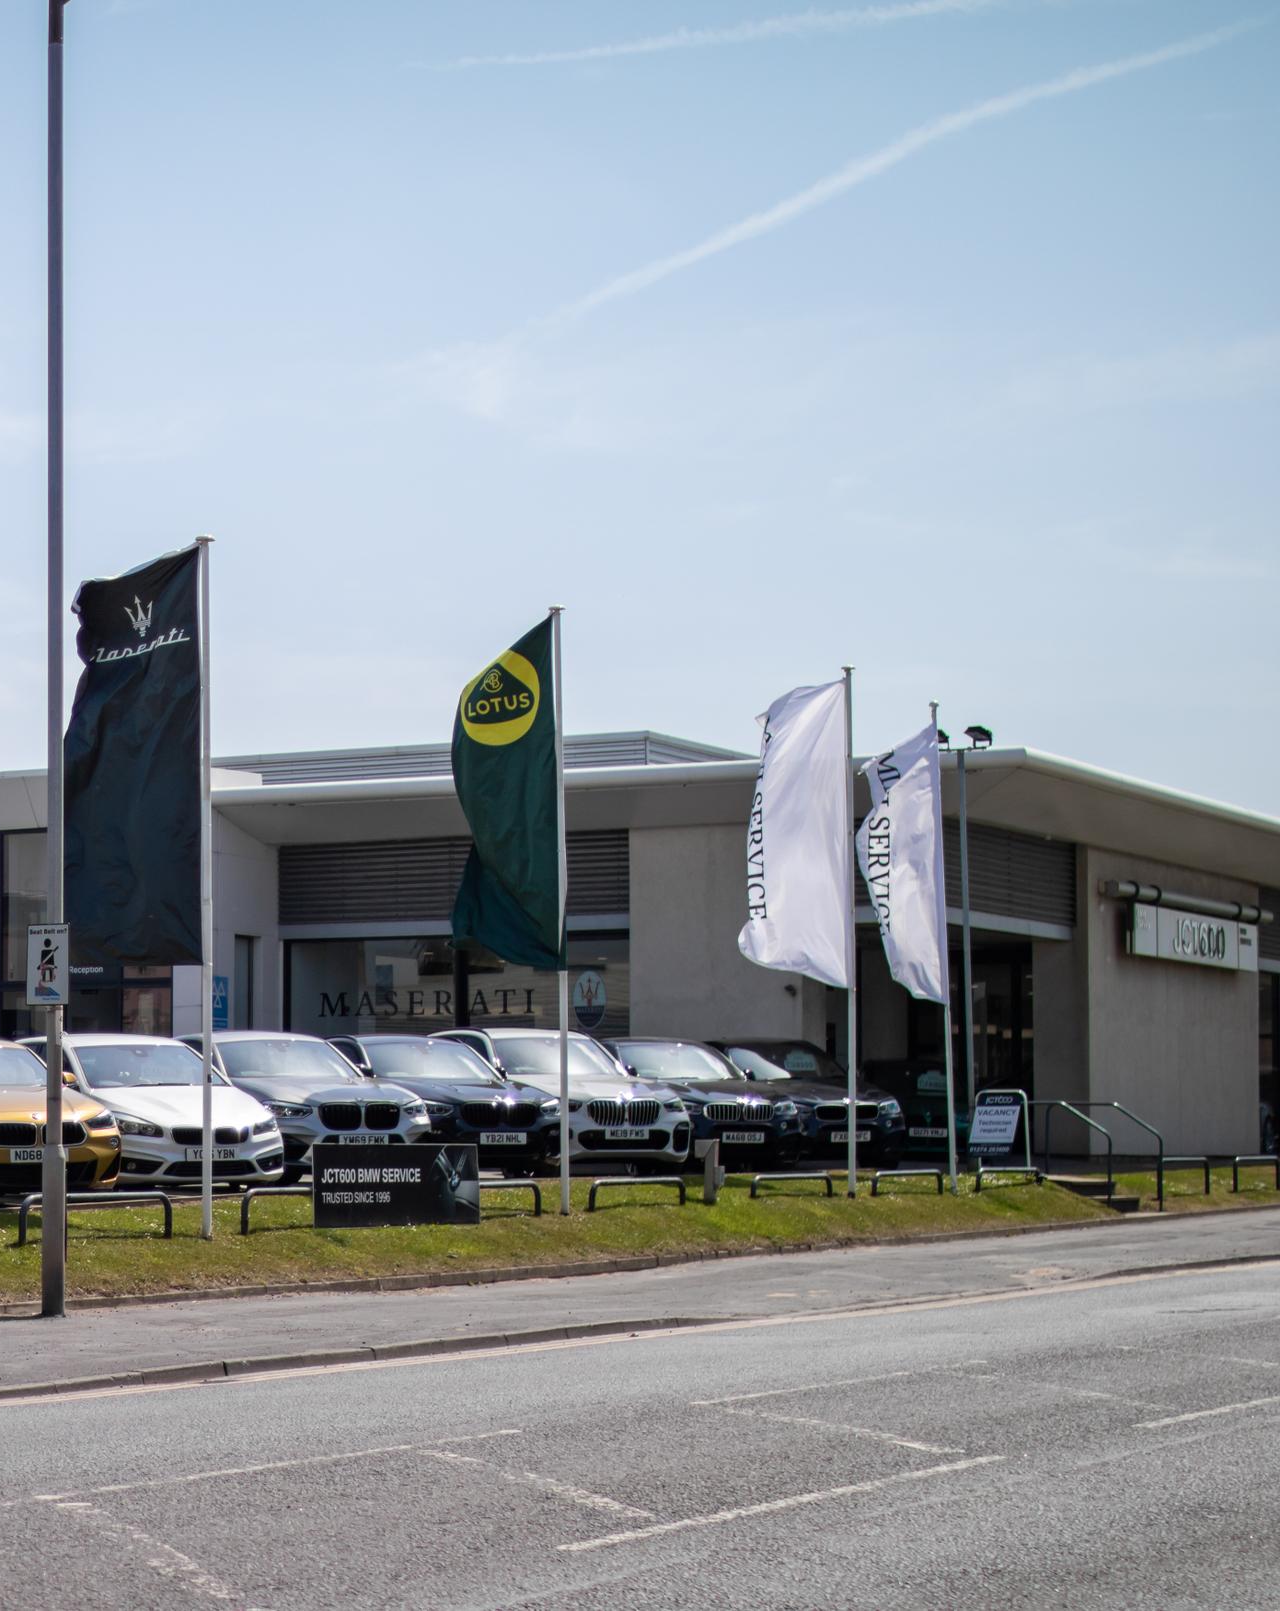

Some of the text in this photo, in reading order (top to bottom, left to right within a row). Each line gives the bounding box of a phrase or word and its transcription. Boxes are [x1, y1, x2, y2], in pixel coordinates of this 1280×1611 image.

[467, 692, 531, 717] LOTUS
[747, 791, 767, 921] SERVICE
[69, 965, 104, 975] Reception
[318, 988, 536, 1018] MASERATI
[14, 1150, 42, 1160] ND68
[217, 1149, 235, 1159] YBN
[321, 1168, 422, 1184] JCT600 BMW SERVICE
[322, 1191, 391, 1204] TRUSTED SINCE 1996
